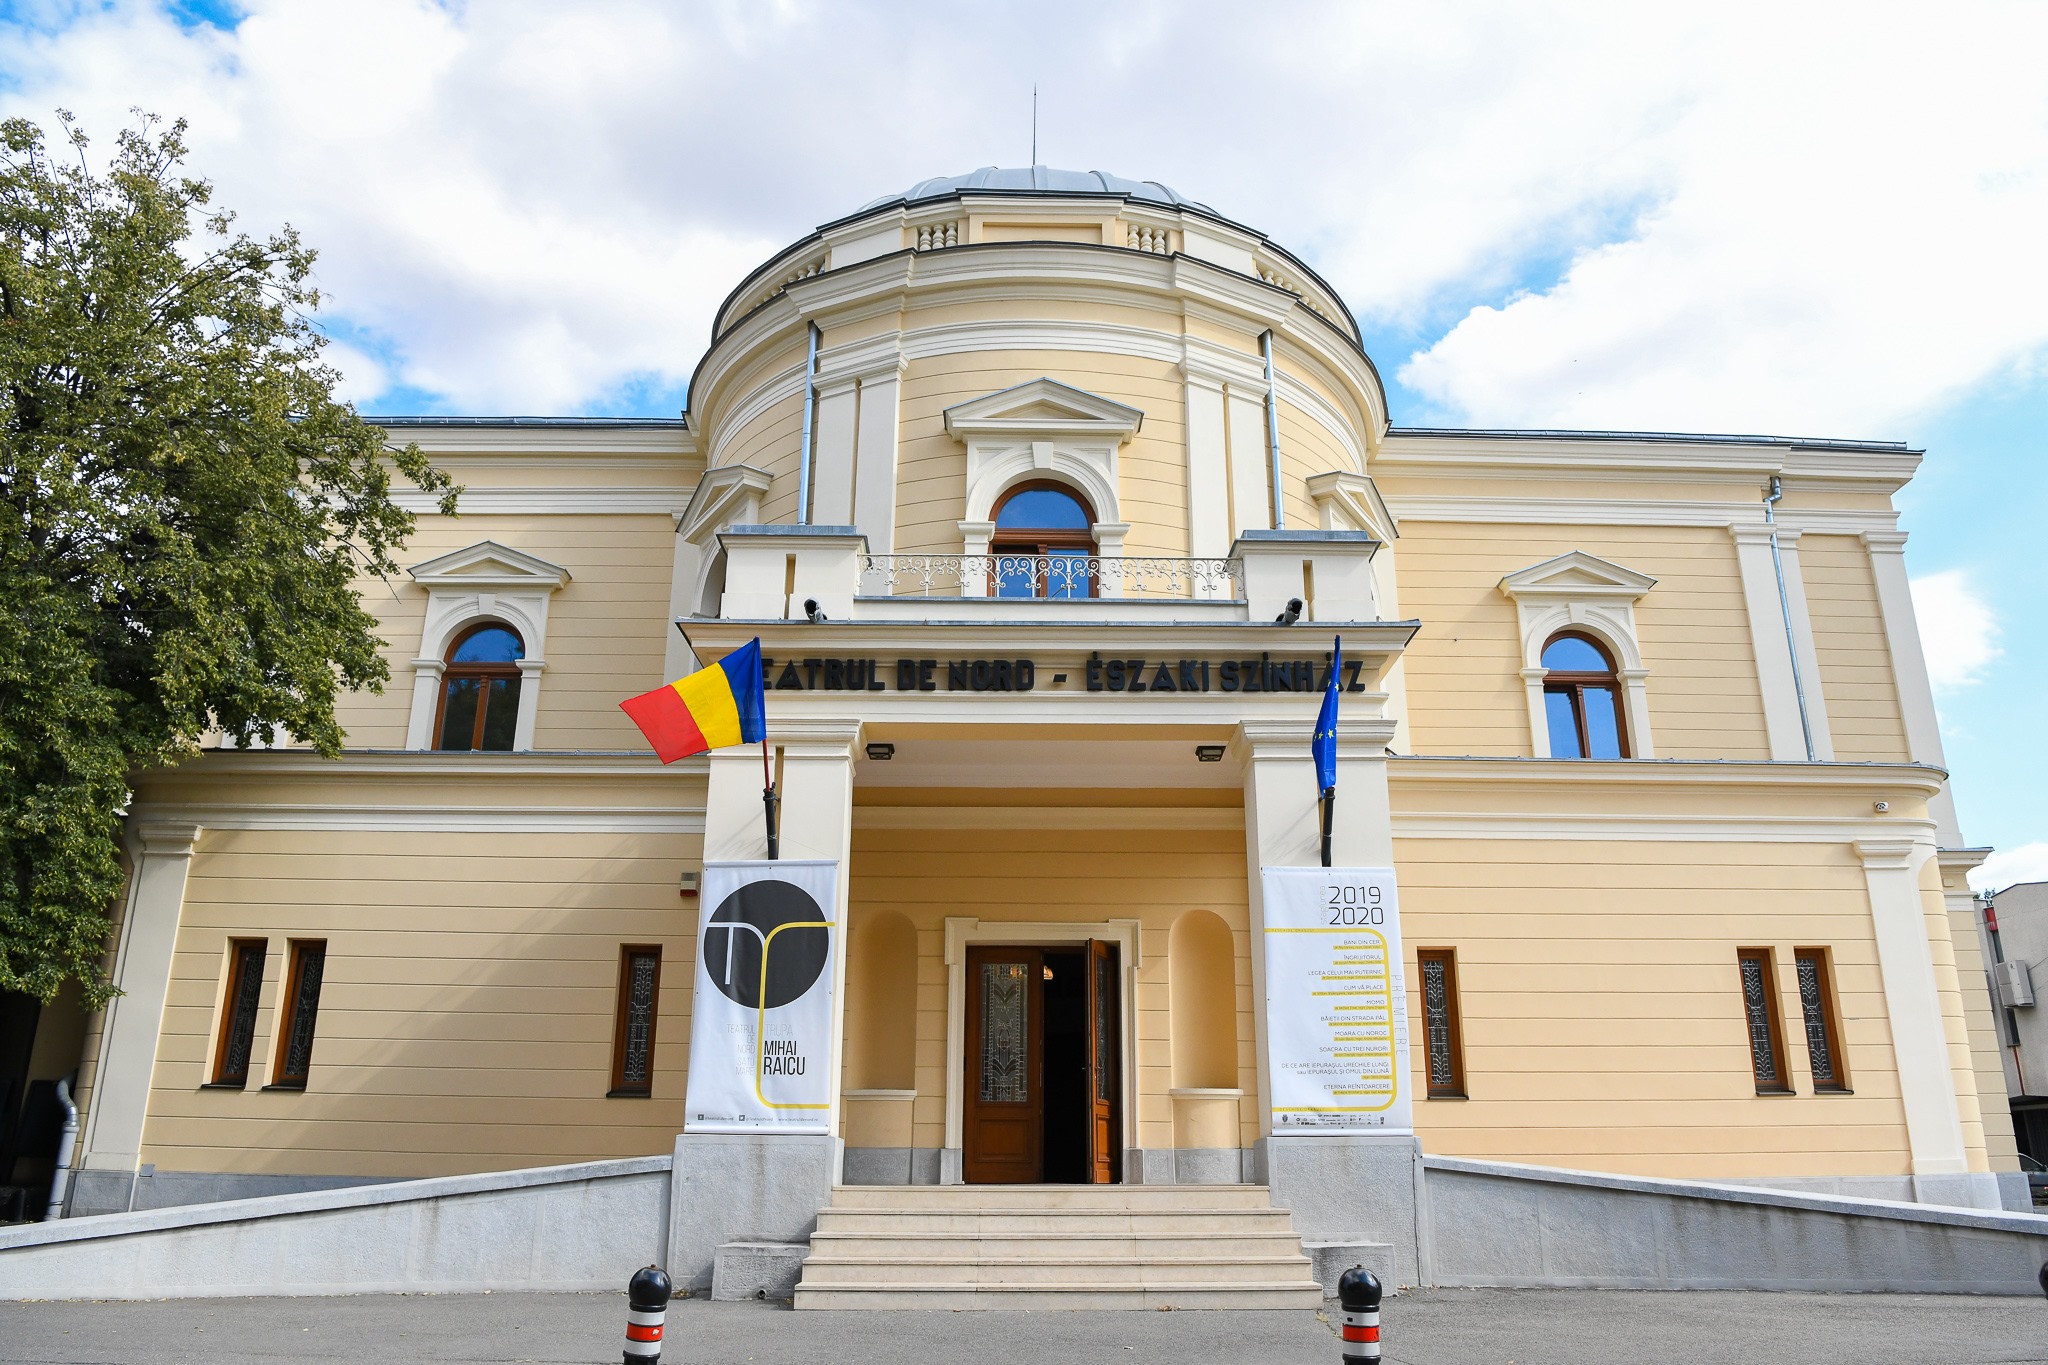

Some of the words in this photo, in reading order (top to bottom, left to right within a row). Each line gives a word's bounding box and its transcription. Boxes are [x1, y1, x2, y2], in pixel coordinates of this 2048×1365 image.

[761, 658, 886, 690] EATRUL
[897, 659, 937, 691] DE
[948, 659, 1035, 691] NORD
[1086, 651, 1210, 691] ÉSZAKI
[1328, 886, 1381, 904] 2019
[1328, 907, 1384, 925] 2020
[726, 1023, 756, 1034] TEATRUL
[747, 1034, 755, 1044] DE
[765, 1023, 794, 1037] TRUPA
[764, 1040, 797, 1055] MIHAI
[763, 1056, 806, 1075] RAICU
